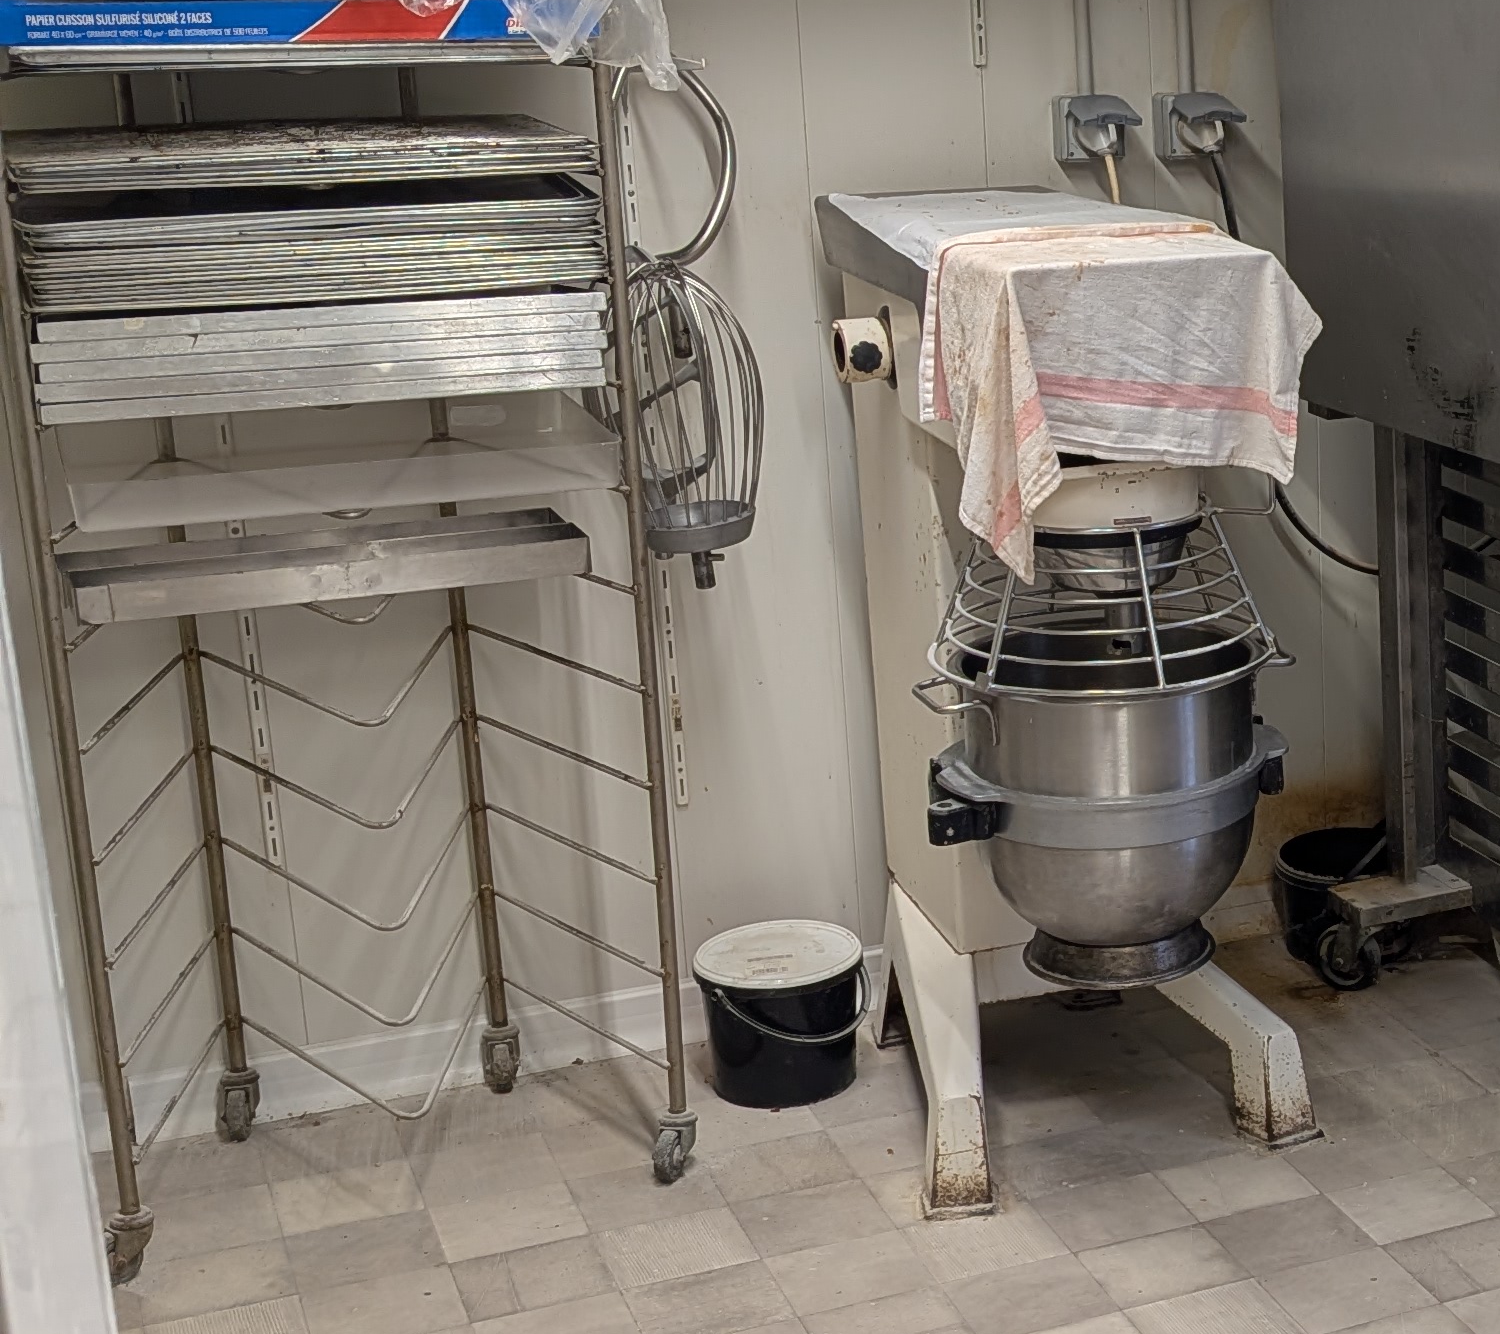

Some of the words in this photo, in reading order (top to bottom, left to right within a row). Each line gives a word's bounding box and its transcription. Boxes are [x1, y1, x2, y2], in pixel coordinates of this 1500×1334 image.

[25, 14, 55, 26] PAPIER
[56, 13, 94, 26] CUISSON
[95, 11, 141, 25] SULFURISÉ
[141, 10, 178, 25] SILICONÉ
[180, 13, 186, 24] 2
[187, 12, 213, 24] FACES
